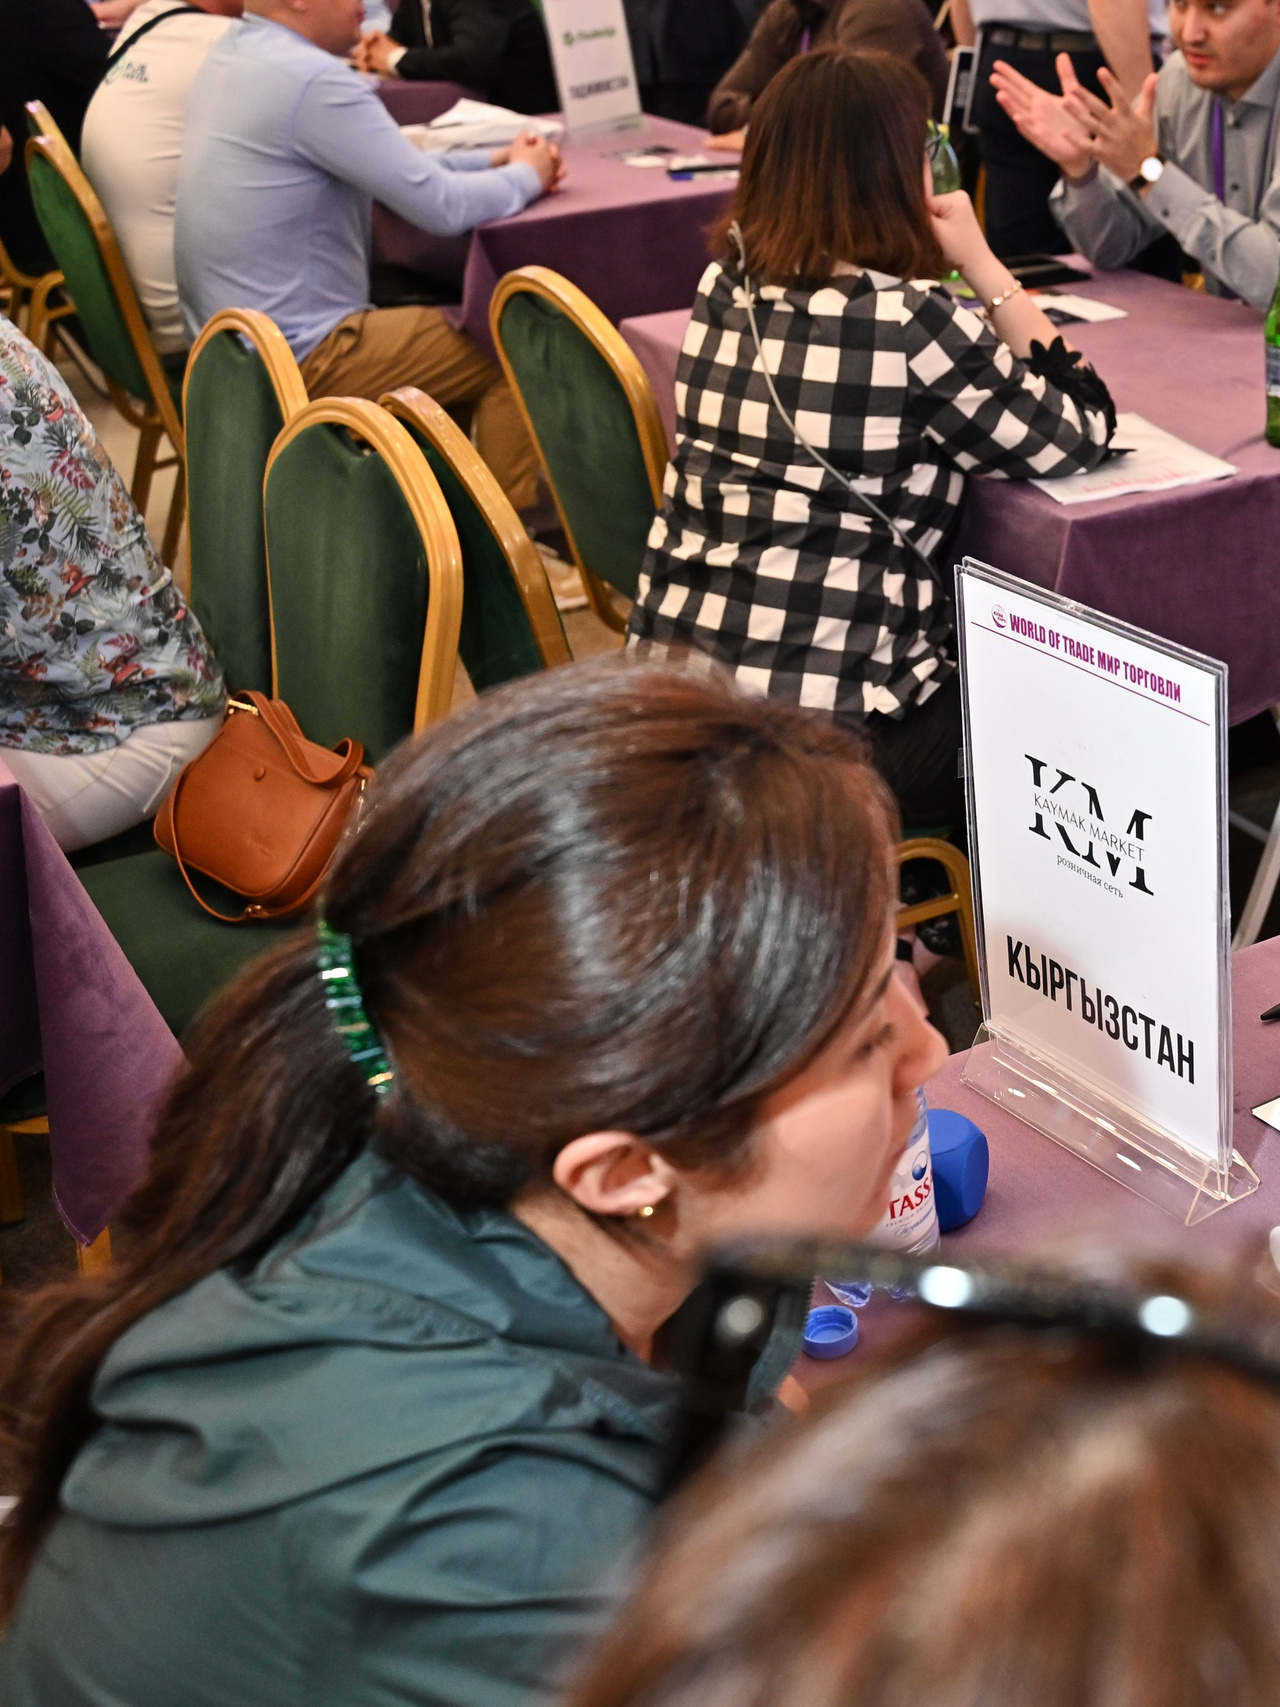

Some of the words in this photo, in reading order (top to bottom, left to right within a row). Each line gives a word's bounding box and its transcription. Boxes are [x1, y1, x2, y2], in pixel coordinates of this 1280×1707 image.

[1009, 613, 1046, 644] WORLD
[1048, 629, 1061, 650] OF
[1062, 635, 1095, 665] TRADE
[1097, 650, 1121, 676] МИР
[1123, 661, 1181, 703] ТОРГОВЛИ
[1034, 792, 1087, 833] KAYMAK
[1089, 823, 1145, 862] MARKET
[1056, 854, 1102, 888] розничная
[1103, 881, 1124, 899] сеть
[1006, 934, 1195, 1085] КЫРГЫЗСТАН
[888, 1169, 933, 1220] TASS
